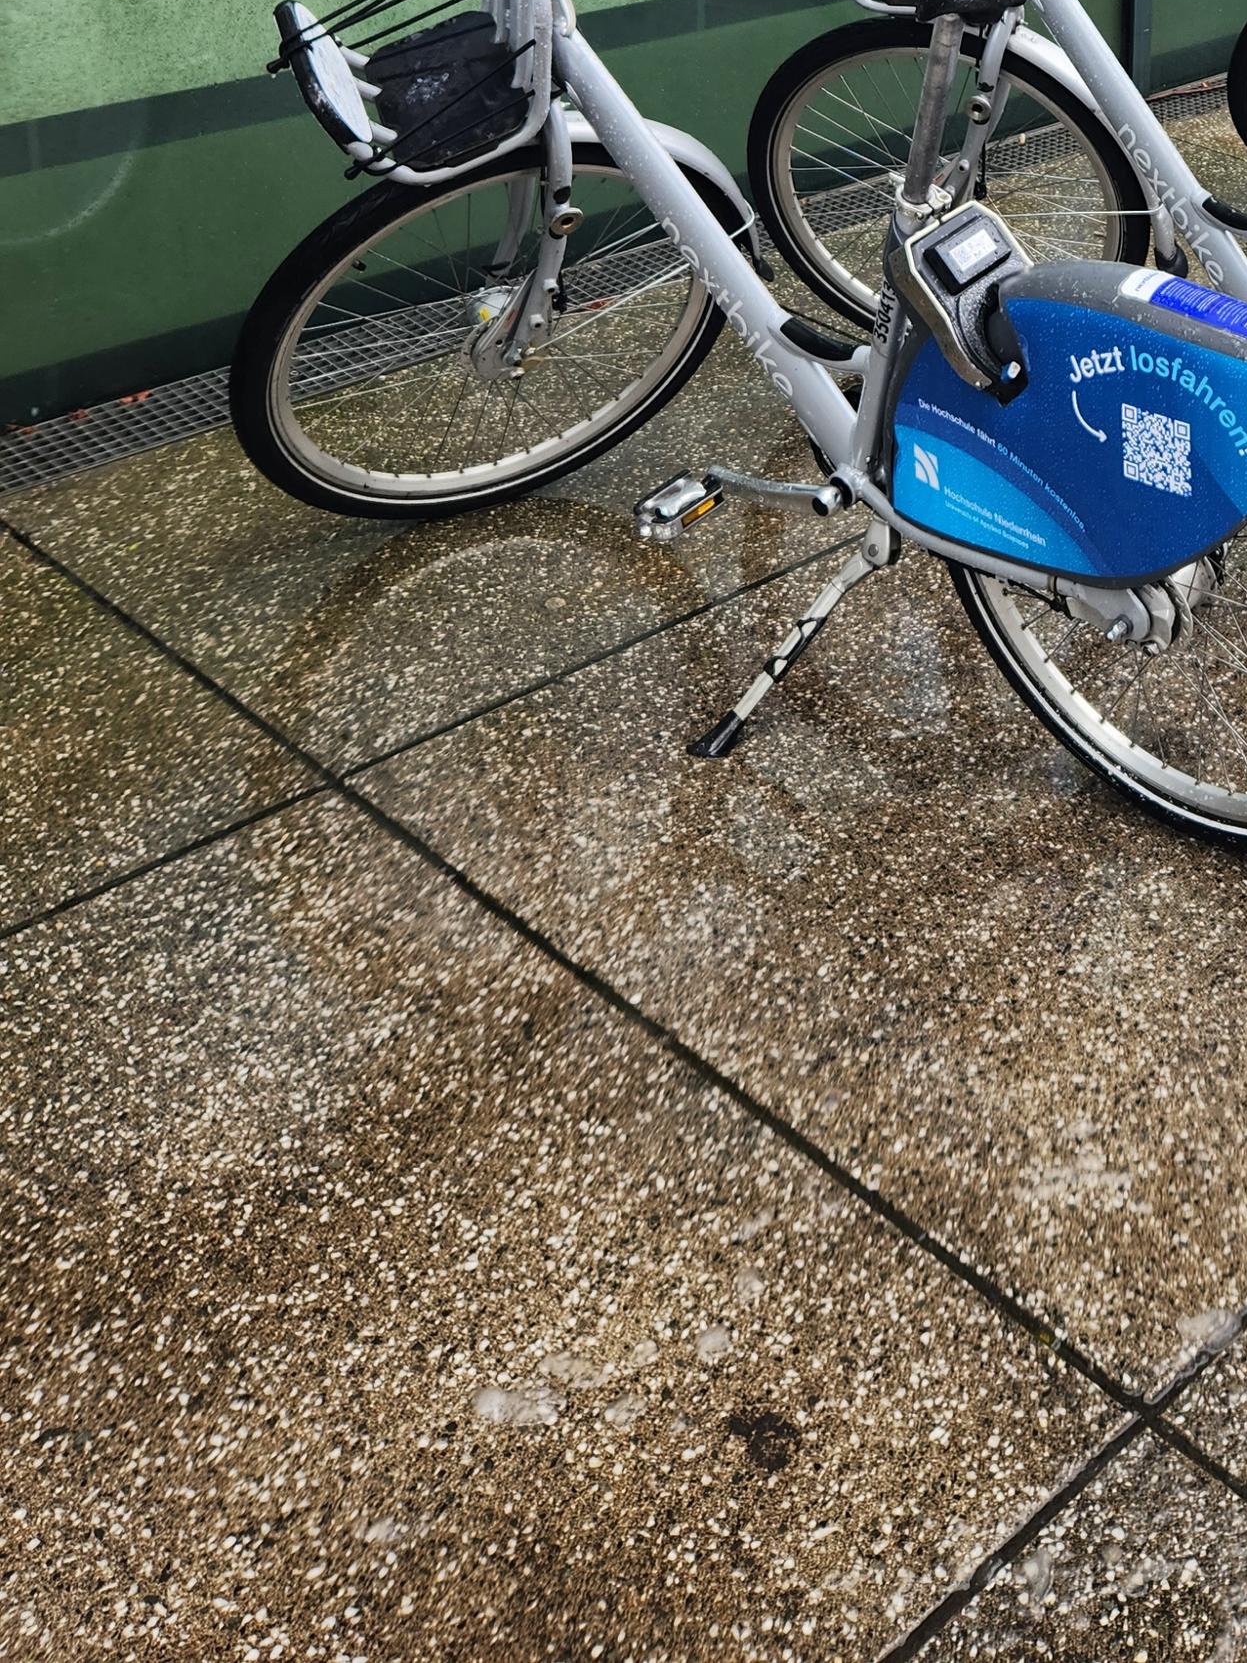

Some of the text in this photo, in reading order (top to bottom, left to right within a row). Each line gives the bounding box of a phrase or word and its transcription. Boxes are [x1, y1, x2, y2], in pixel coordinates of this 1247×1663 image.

[1117, 123, 1224, 287] nextbike
[1069, 345, 1125, 383] Jetzt
[918, 398, 1086, 532] Die Hochschule fährt 60 Minuten kostenlos.
[944, 486, 1047, 547] Hochschule Niederrhein
